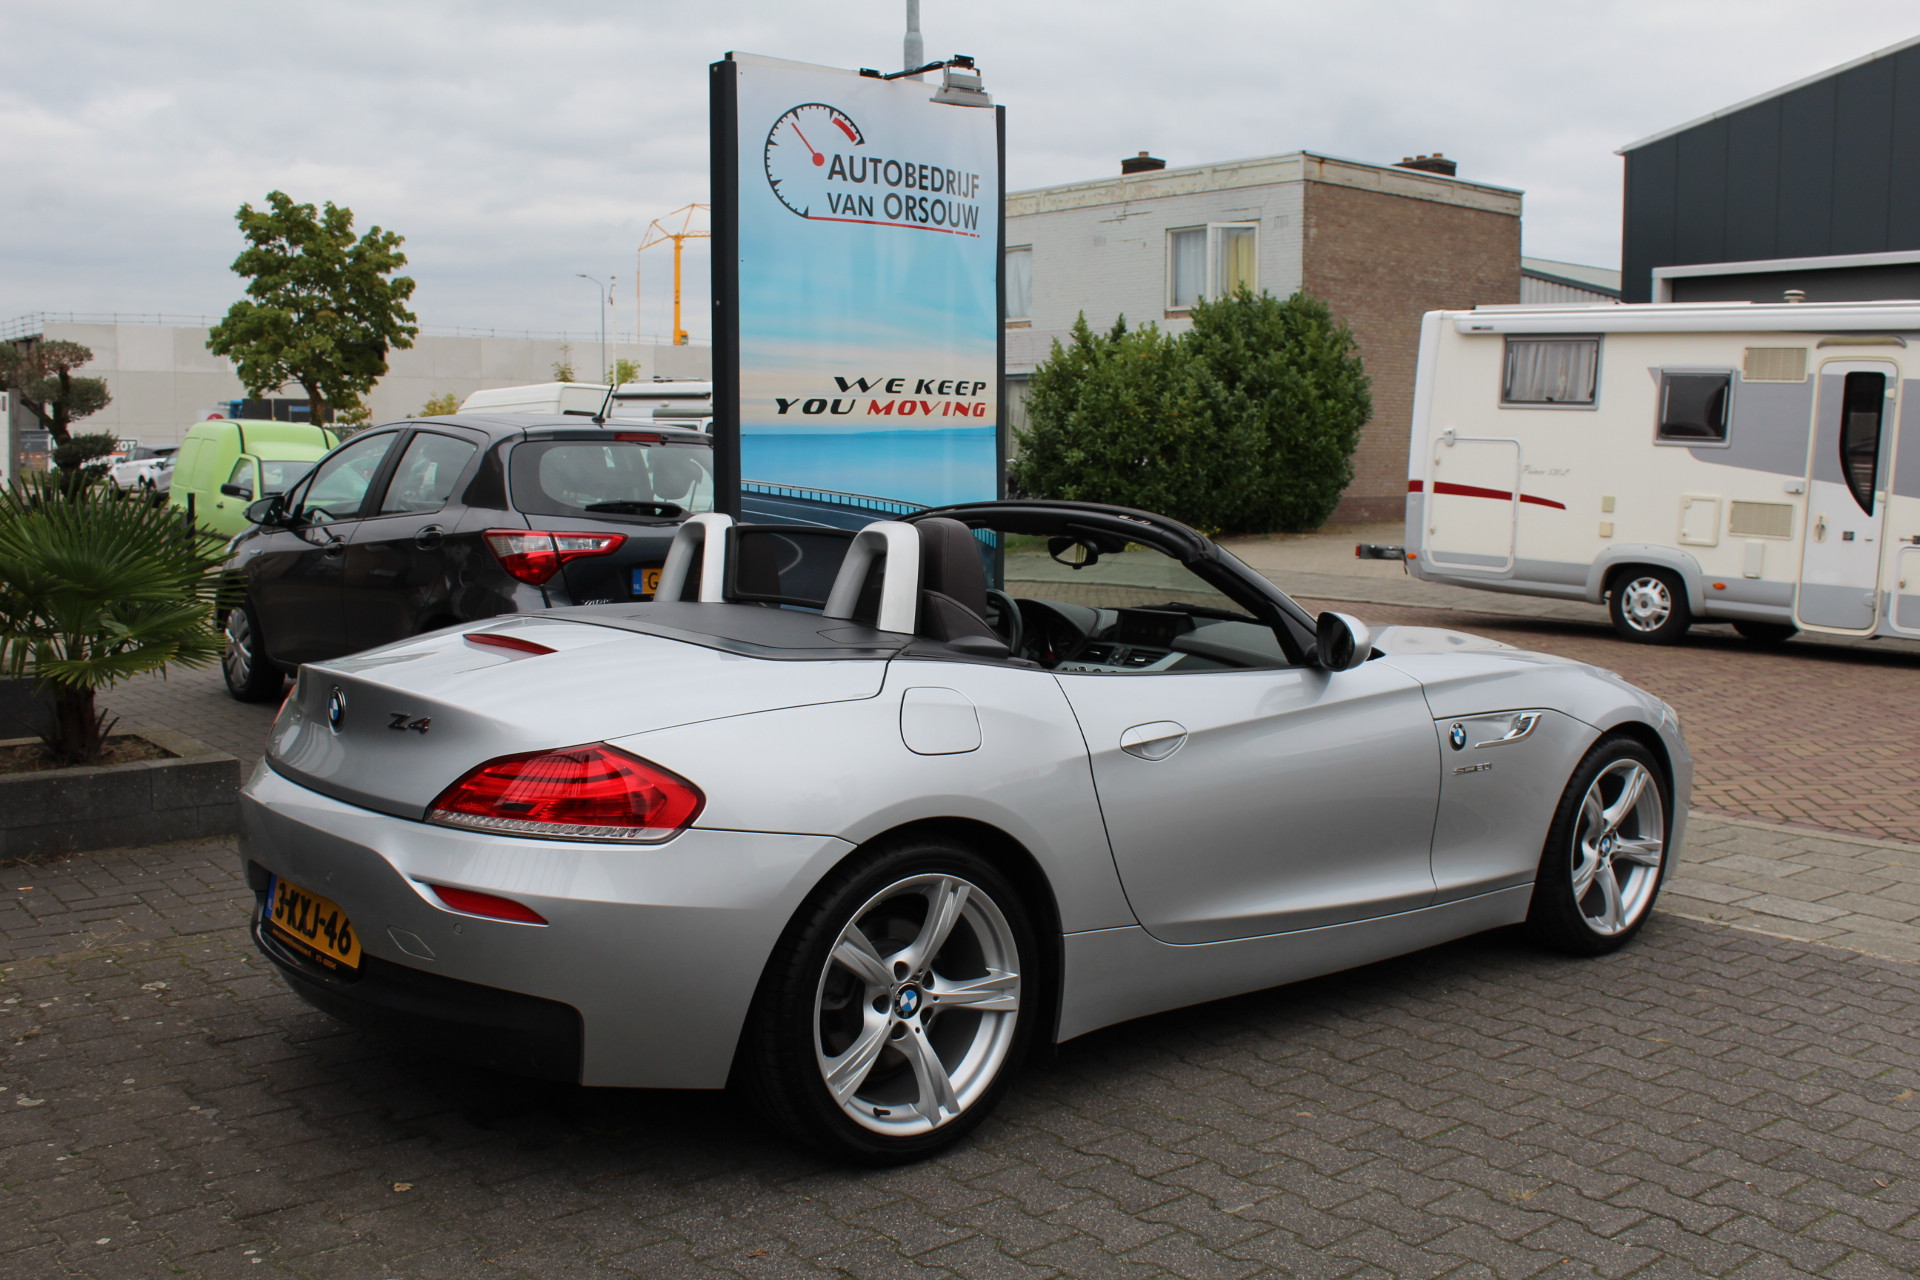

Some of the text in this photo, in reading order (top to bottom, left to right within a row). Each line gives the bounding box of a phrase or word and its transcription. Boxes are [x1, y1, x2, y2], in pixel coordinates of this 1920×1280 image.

[827, 154, 980, 199] AUTOBEDRIJF
[827, 192, 979, 231] VAN ORSOUW
[834, 376, 987, 396] WE KEEP
[775, 398, 987, 417] YOU MOVING
[388, 712, 432, 734] Z4
[275, 883, 352, 956] 3-KXJ-46
